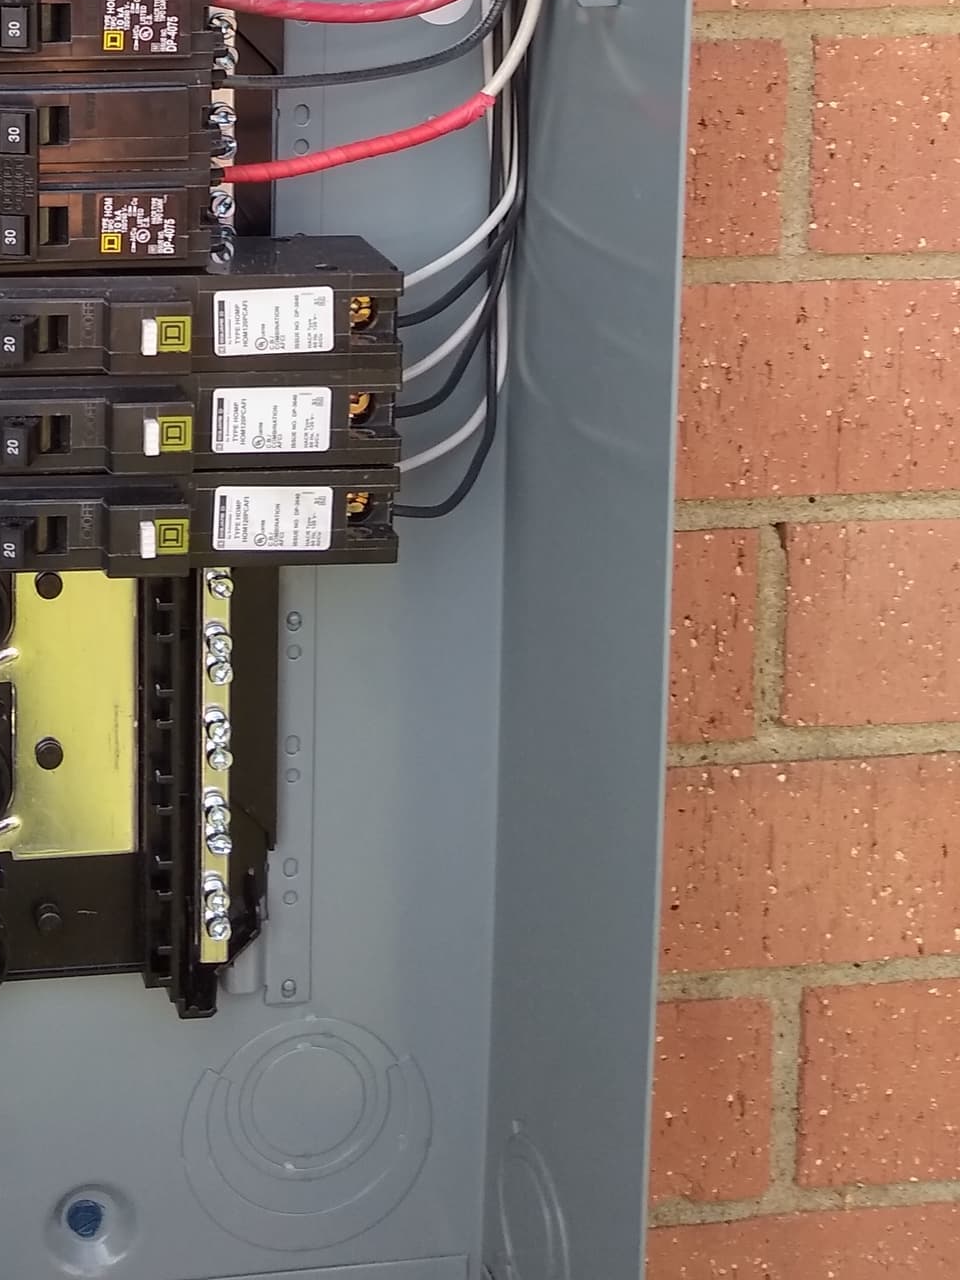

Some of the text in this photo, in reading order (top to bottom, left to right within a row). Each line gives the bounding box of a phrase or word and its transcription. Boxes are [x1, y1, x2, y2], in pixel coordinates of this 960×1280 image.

[8, 21, 20, 37] 30
[167, 16, 178, 52] DP-4075
[8, 127, 20, 142] 30
[104, 198, 113, 217] HOM
[5, 230, 17, 245] 30
[164, 219, 175, 254] DP-4075
[4, 337, 15, 352] 20
[7, 439, 19, 455] 20
[4, 543, 15, 558] 20
